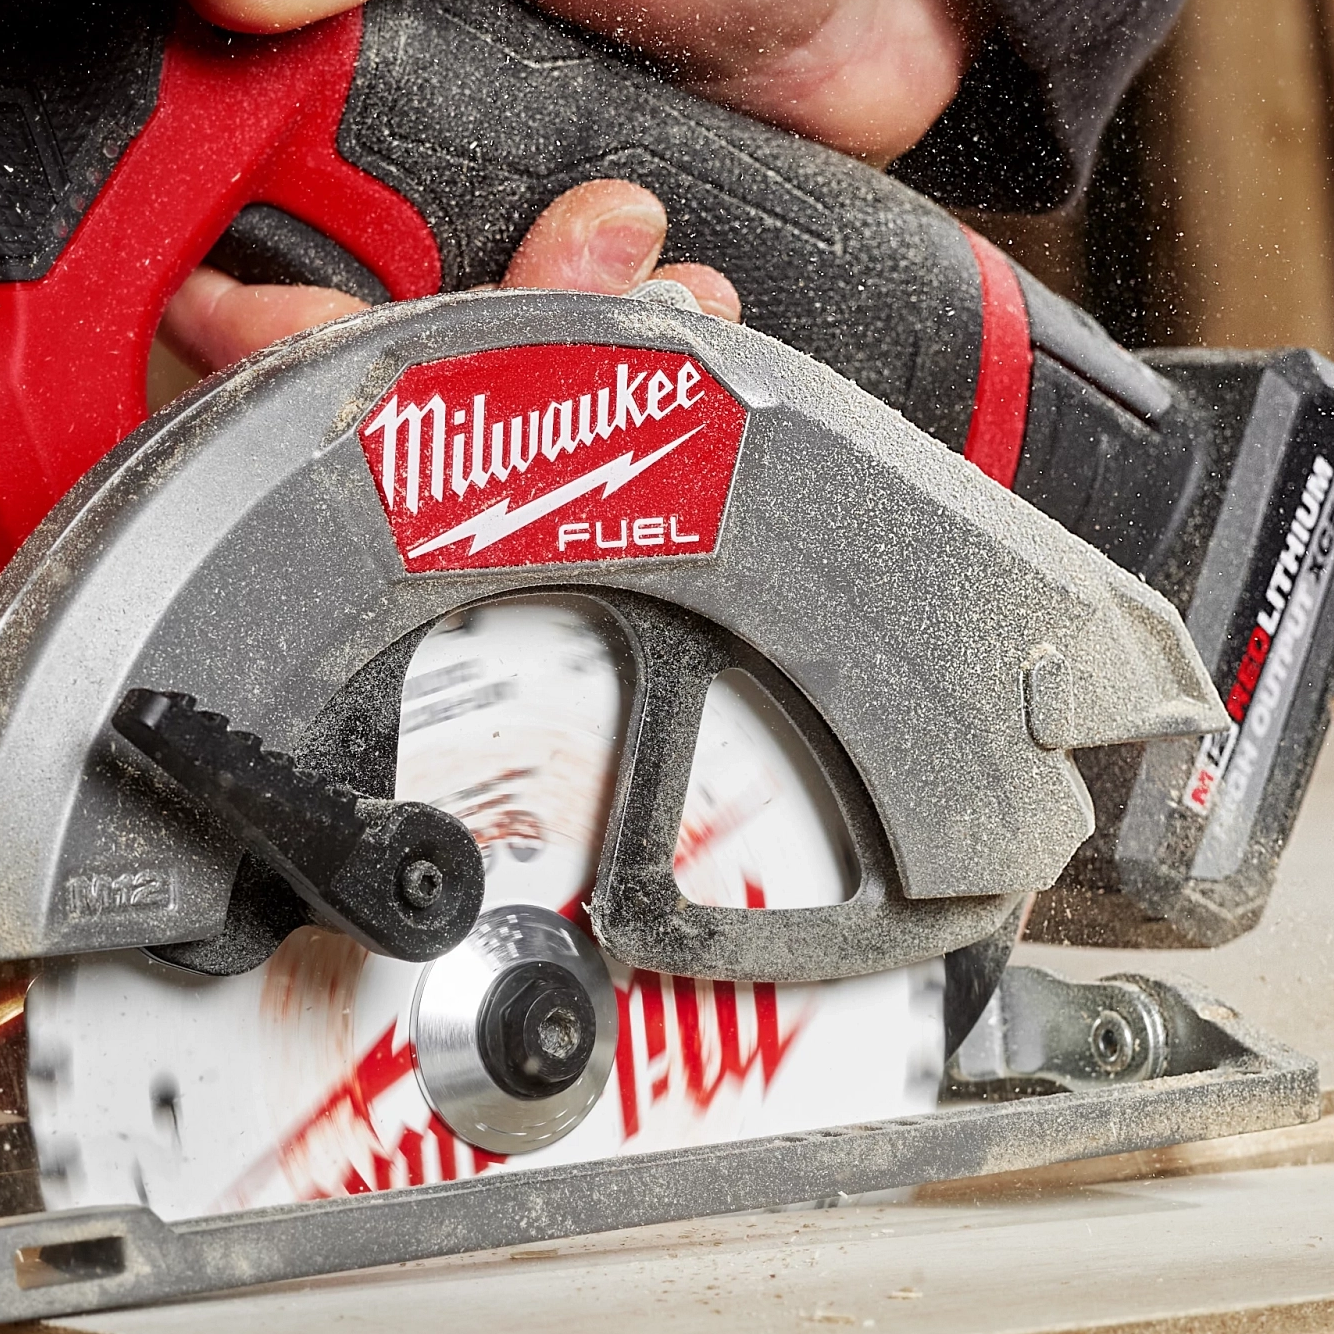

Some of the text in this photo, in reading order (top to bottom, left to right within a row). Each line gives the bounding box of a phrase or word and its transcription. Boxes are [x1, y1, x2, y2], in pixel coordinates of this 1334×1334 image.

[365, 361, 707, 514] Milwaukee
[558, 516, 700, 552] FUEL
[1226, 454, 1334, 722] REDLITHIUM
[1251, 581, 1314, 738] OUTPUT
[67, 869, 162, 917] M12
